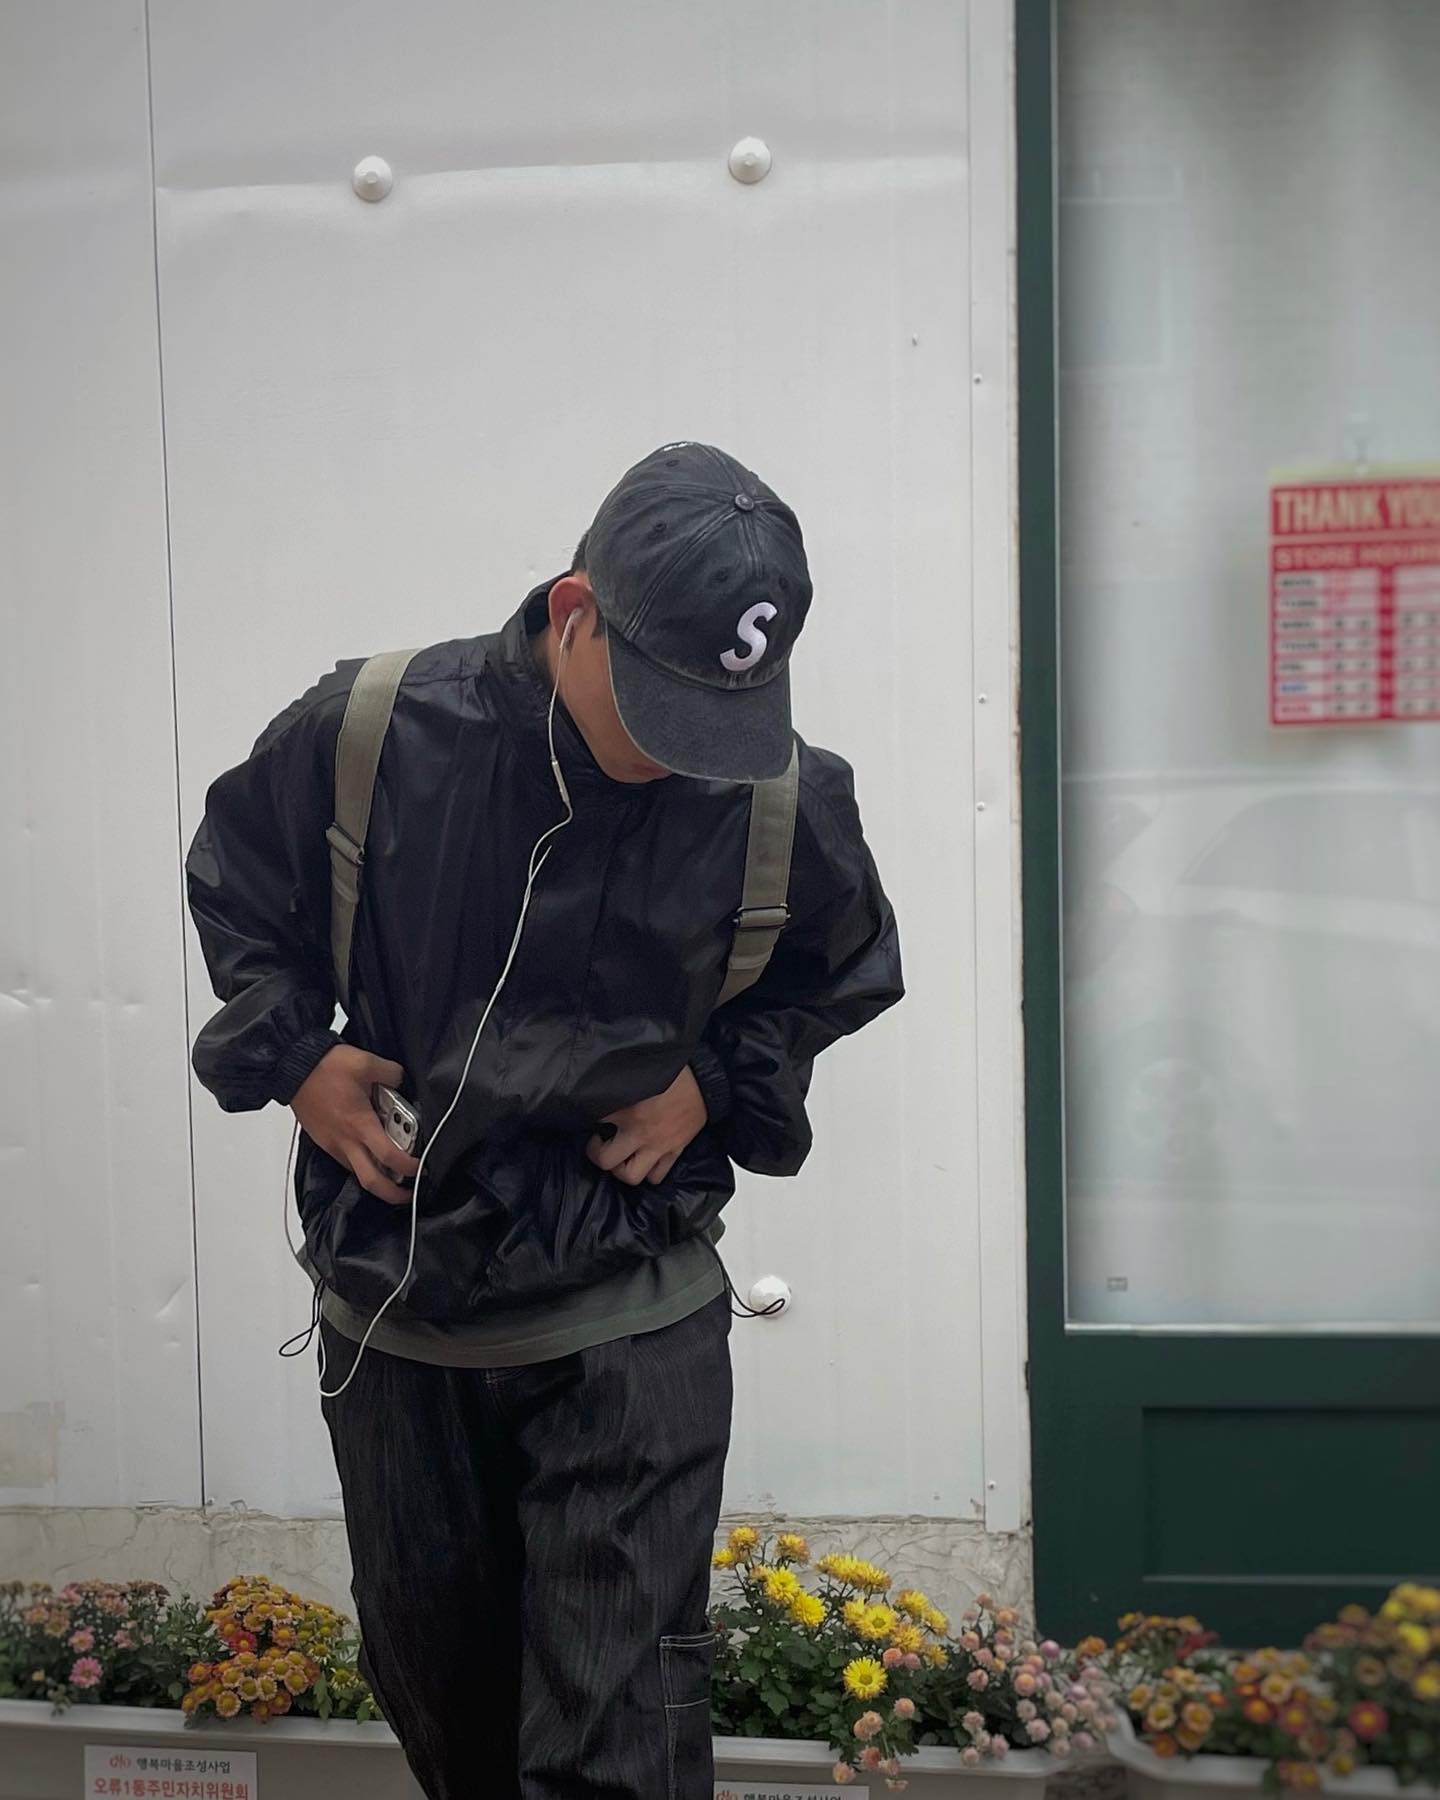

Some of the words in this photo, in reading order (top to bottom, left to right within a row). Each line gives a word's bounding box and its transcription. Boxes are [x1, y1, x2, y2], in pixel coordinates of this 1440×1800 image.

[1276, 489, 1382, 532] THANK
[719, 601, 777, 672] S
[136, 1757, 231, 1774] 행복마을조성사업
[95, 1777, 249, 1800] 오류1동주민자치위원회
